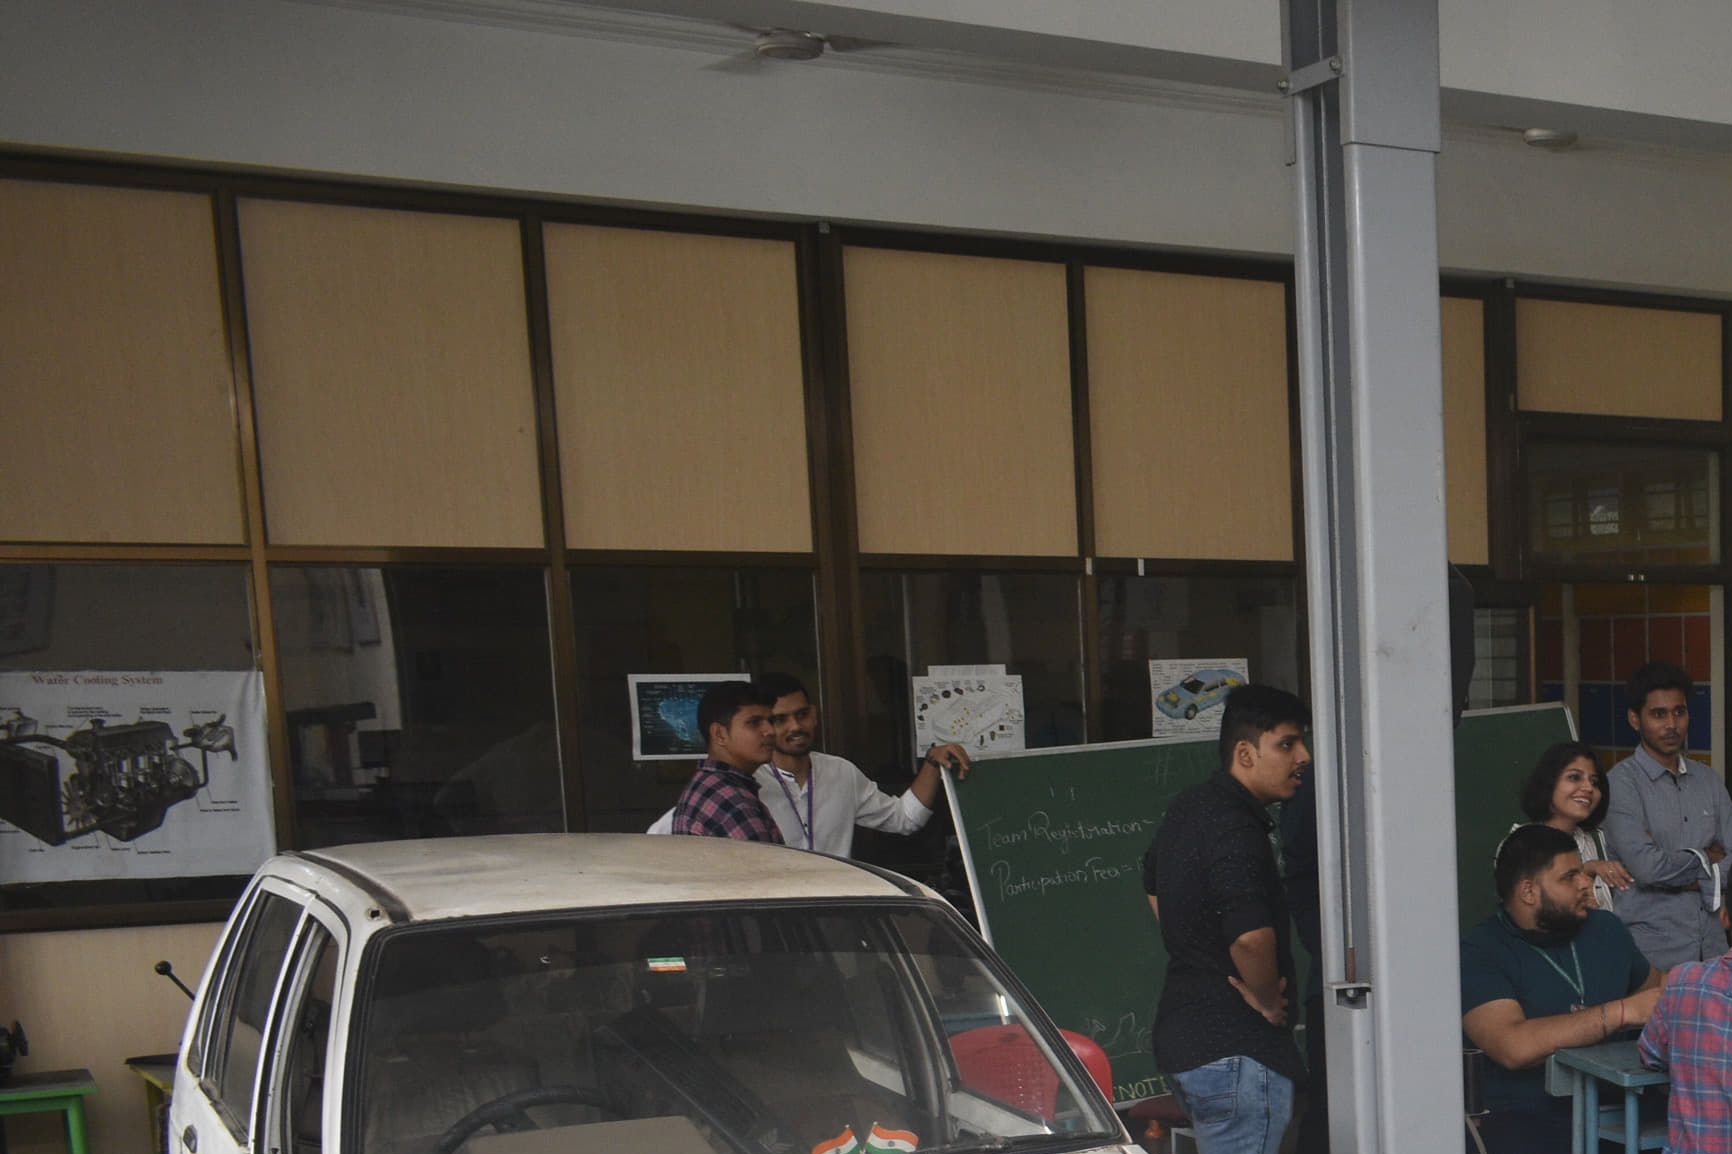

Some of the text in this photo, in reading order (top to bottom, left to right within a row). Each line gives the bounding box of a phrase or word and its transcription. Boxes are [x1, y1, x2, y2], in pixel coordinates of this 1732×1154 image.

[72, 674, 119, 687] Cooling
[120, 674, 163, 687] System
[976, 815, 1028, 850] Team
